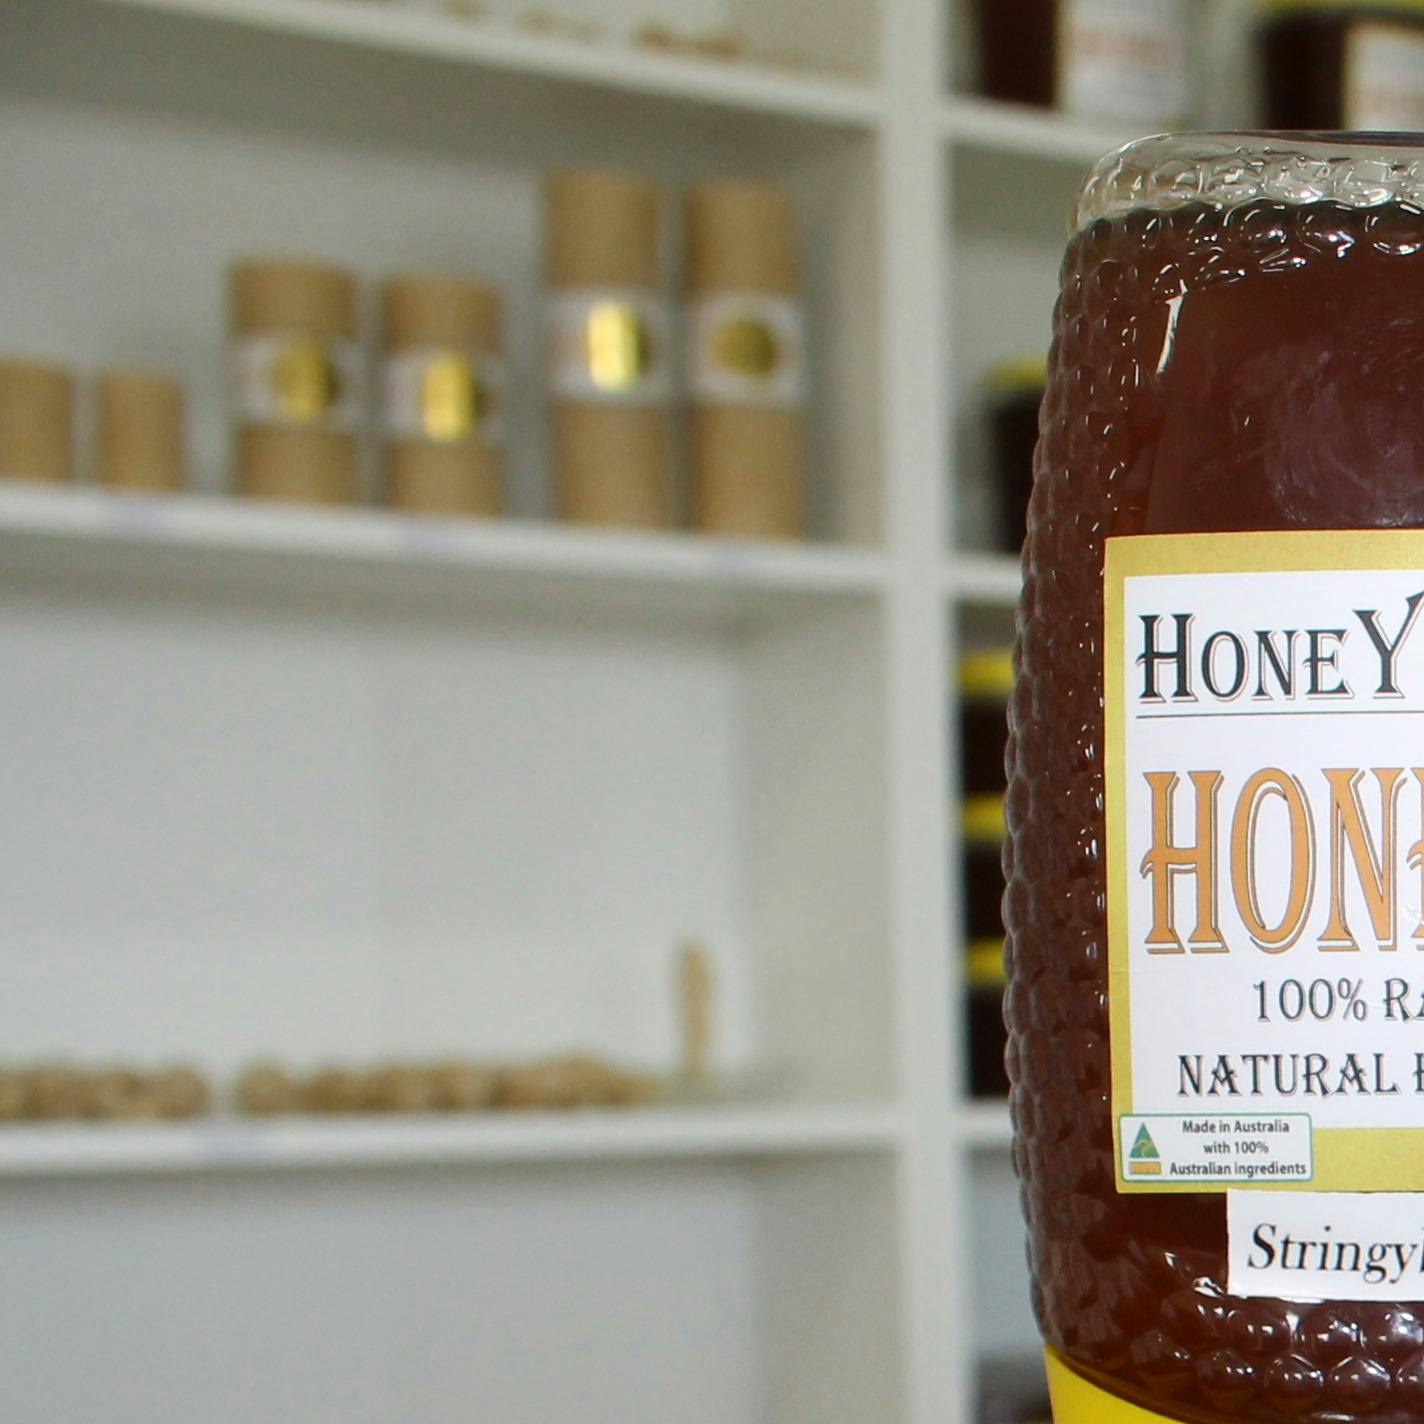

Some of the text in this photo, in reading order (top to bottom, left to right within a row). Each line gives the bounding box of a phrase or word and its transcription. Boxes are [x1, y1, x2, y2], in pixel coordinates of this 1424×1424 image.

[1253, 979, 1370, 1025] 100%
[1176, 1051, 1399, 1099] NATURAL
[1182, 1119, 1289, 1133] Made in Australia
[1203, 1141, 1269, 1154] with 100%
[1169, 1162, 1306, 1178] Australian ingredients
